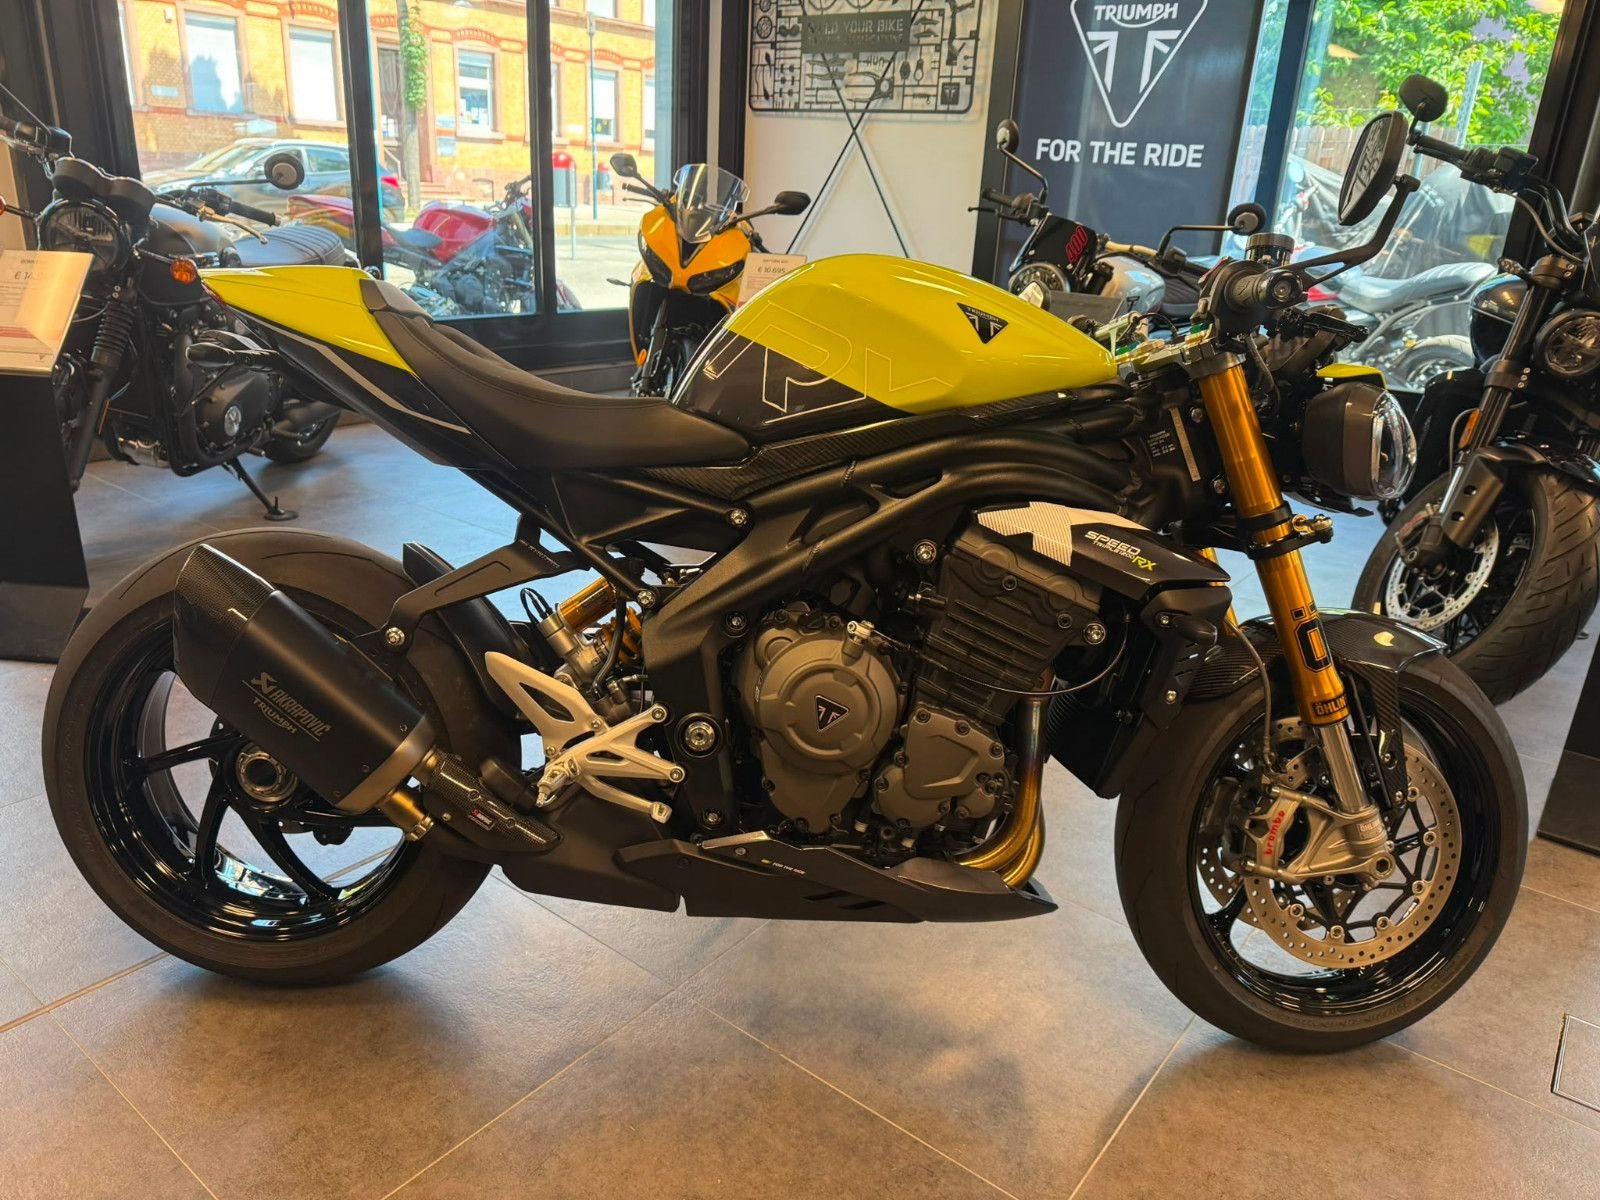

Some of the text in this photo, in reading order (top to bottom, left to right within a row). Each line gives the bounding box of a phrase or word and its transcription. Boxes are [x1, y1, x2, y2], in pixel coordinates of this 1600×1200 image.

[844, 20, 873, 33] YOUR
[877, 18, 904, 32] BIKE
[1094, 2, 1179, 26] TRIUMPH
[1035, 138, 1205, 168] FOR THE RIDE
[1084, 530, 1141, 556] SPEED
[1131, 555, 1157, 572] RX
[253, 696, 298, 735] TRIUMPH
[1314, 697, 1347, 716] ÖHLIN
[1264, 810, 1286, 857] brembo
